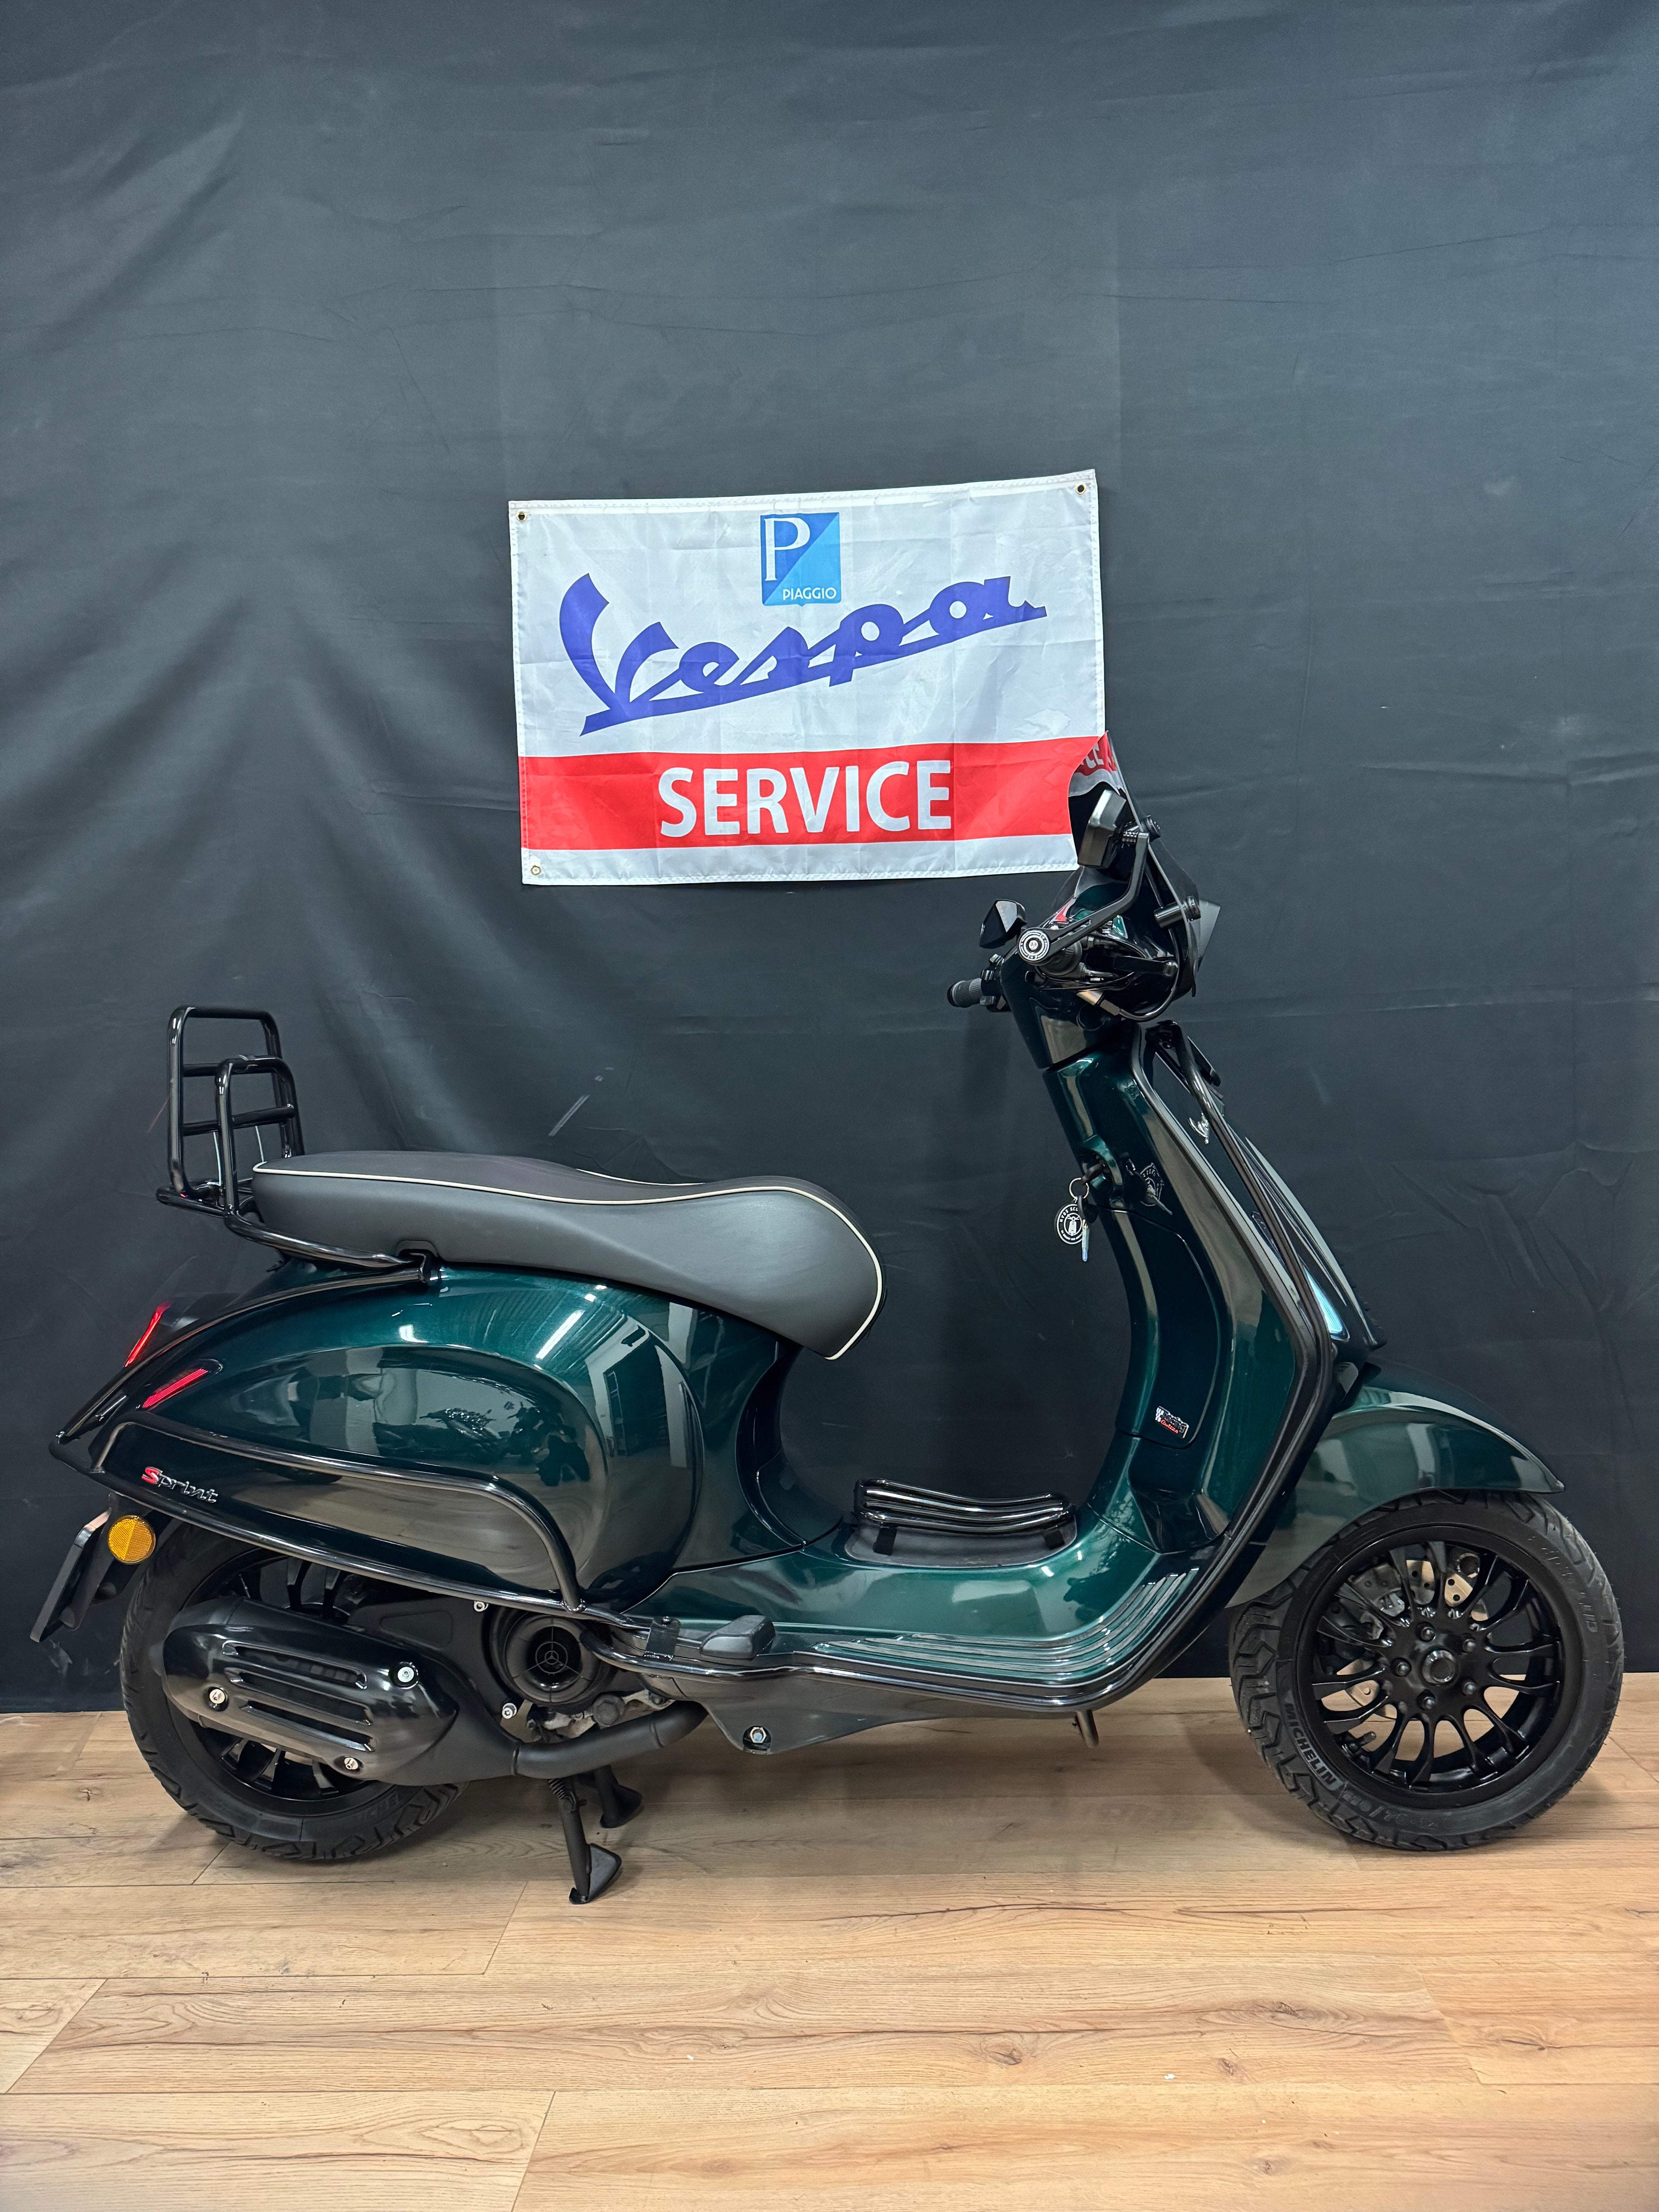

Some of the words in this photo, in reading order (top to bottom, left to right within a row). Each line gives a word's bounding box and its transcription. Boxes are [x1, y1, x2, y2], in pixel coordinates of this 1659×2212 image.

[764, 518, 810, 581] P
[783, 587, 837, 601] PIAGGIO
[560, 574, 1047, 737] Vespa
[659, 760, 951, 837] SERVICE
[142, 1467, 218, 1503] Sprint
[1284, 1703, 1337, 1785] MICHELIN
